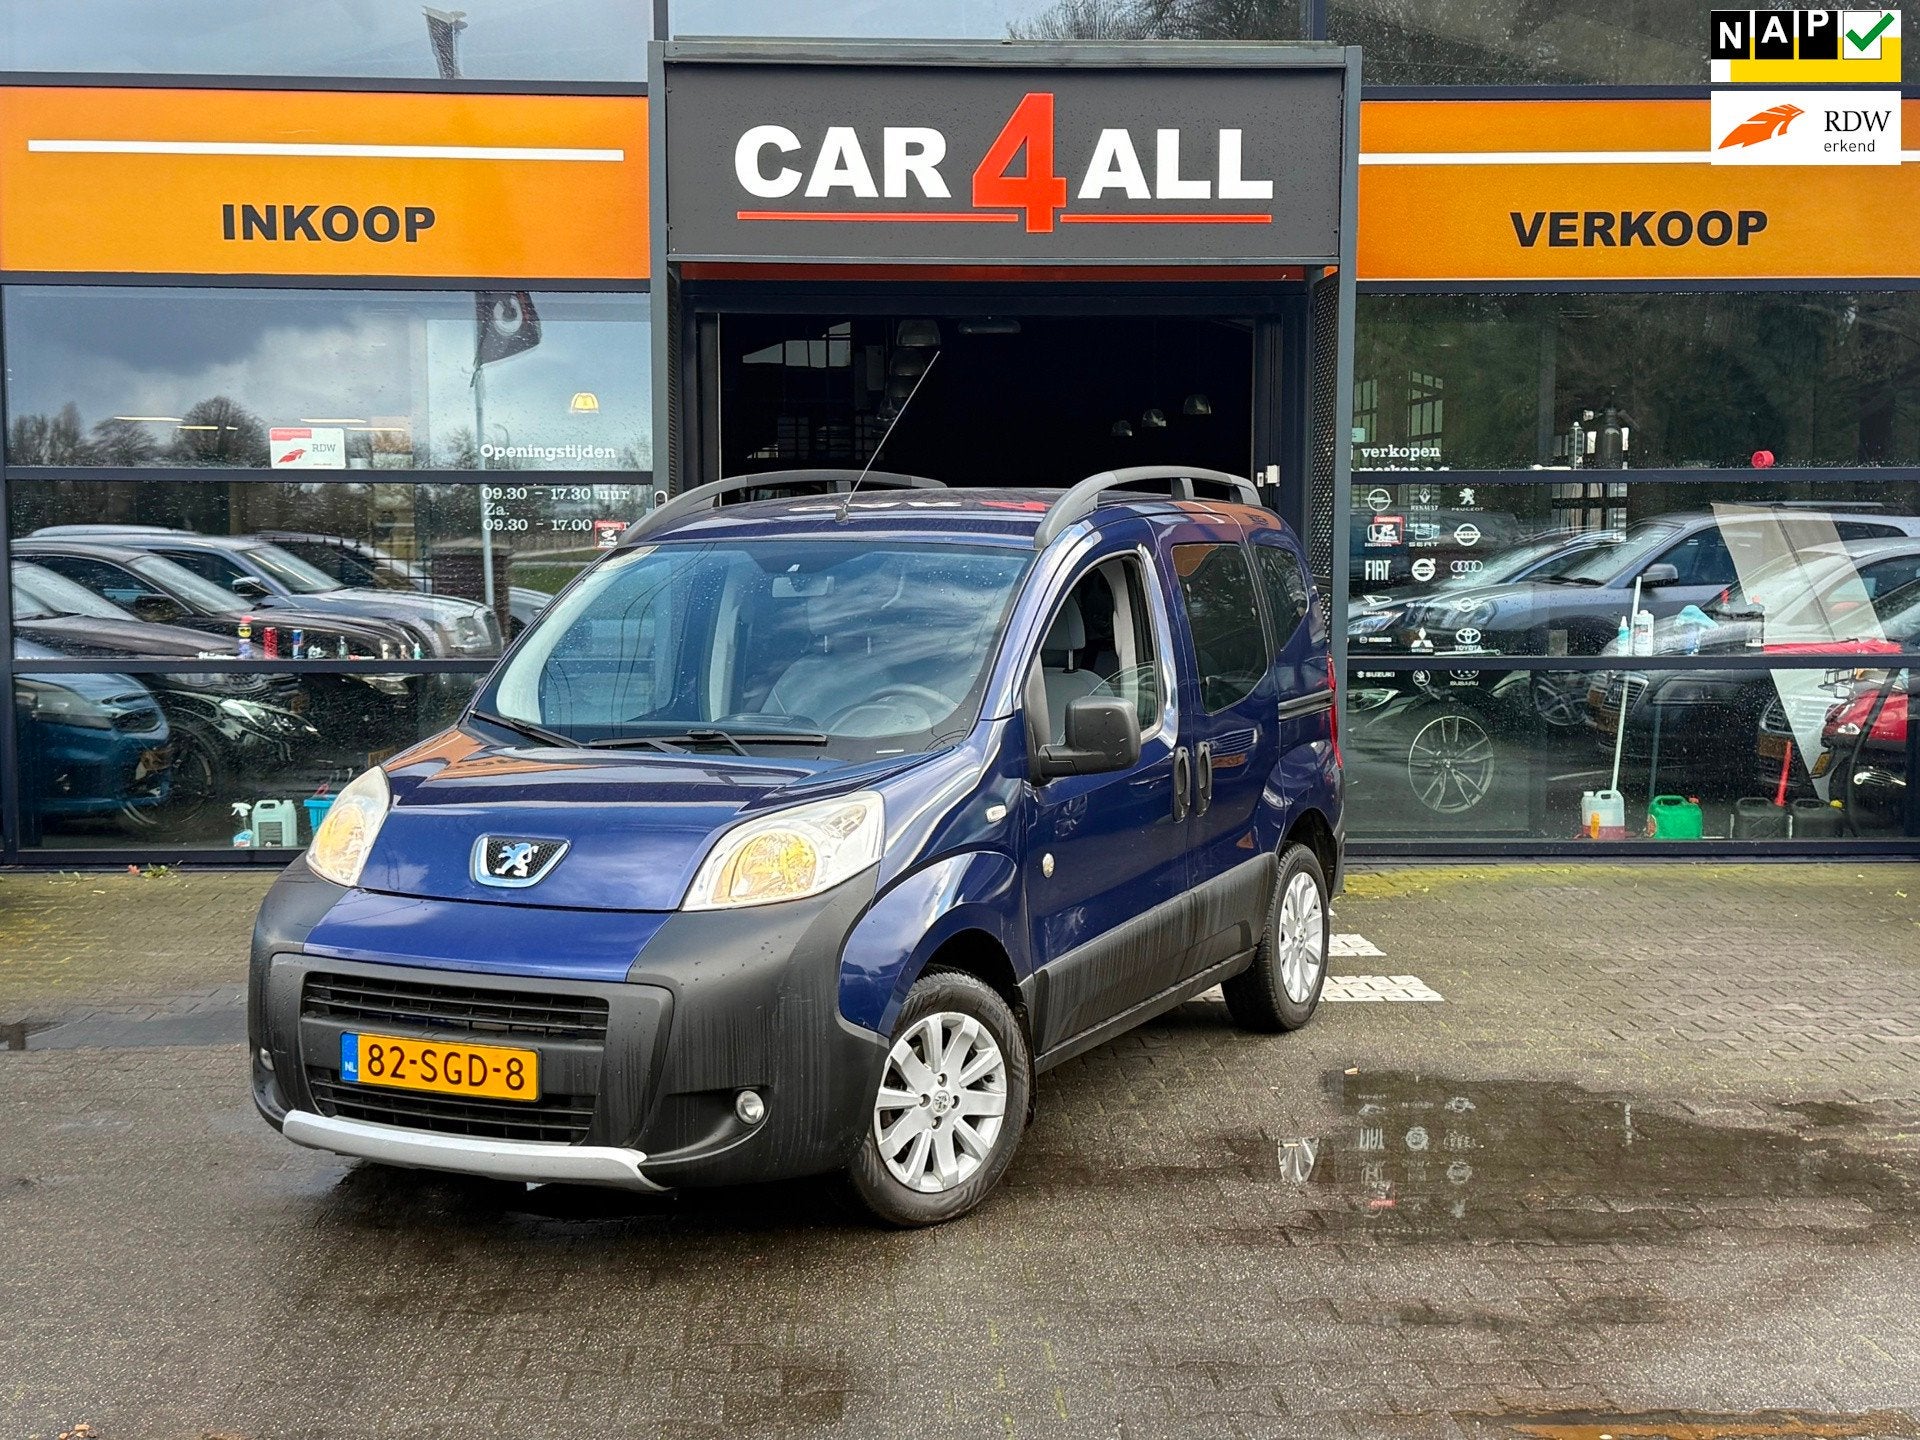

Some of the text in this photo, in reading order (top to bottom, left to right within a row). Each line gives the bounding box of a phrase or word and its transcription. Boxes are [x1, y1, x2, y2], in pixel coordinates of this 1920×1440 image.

[734, 92, 1275, 234] CAR 4 ALL
[222, 204, 436, 243] INKOOP
[1509, 210, 1768, 248] VERKOOP
[312, 443, 336, 453] RDW
[480, 443, 616, 462] Openingstijden
[1361, 444, 1441, 461] verkopen
[482, 487, 528, 500] 09.30
[550, 487, 591, 500] 17.30
[599, 489, 630, 501] uur
[483, 502, 511, 516] Za.
[482, 518, 528, 532] 09.30
[551, 518, 593, 532] 17.00
[1365, 560, 1391, 581] FIAT
[1454, 644, 1483, 652] TOYOTA
[344, 1061, 357, 1073] NL
[367, 1043, 525, 1091] 82-SGD-8
